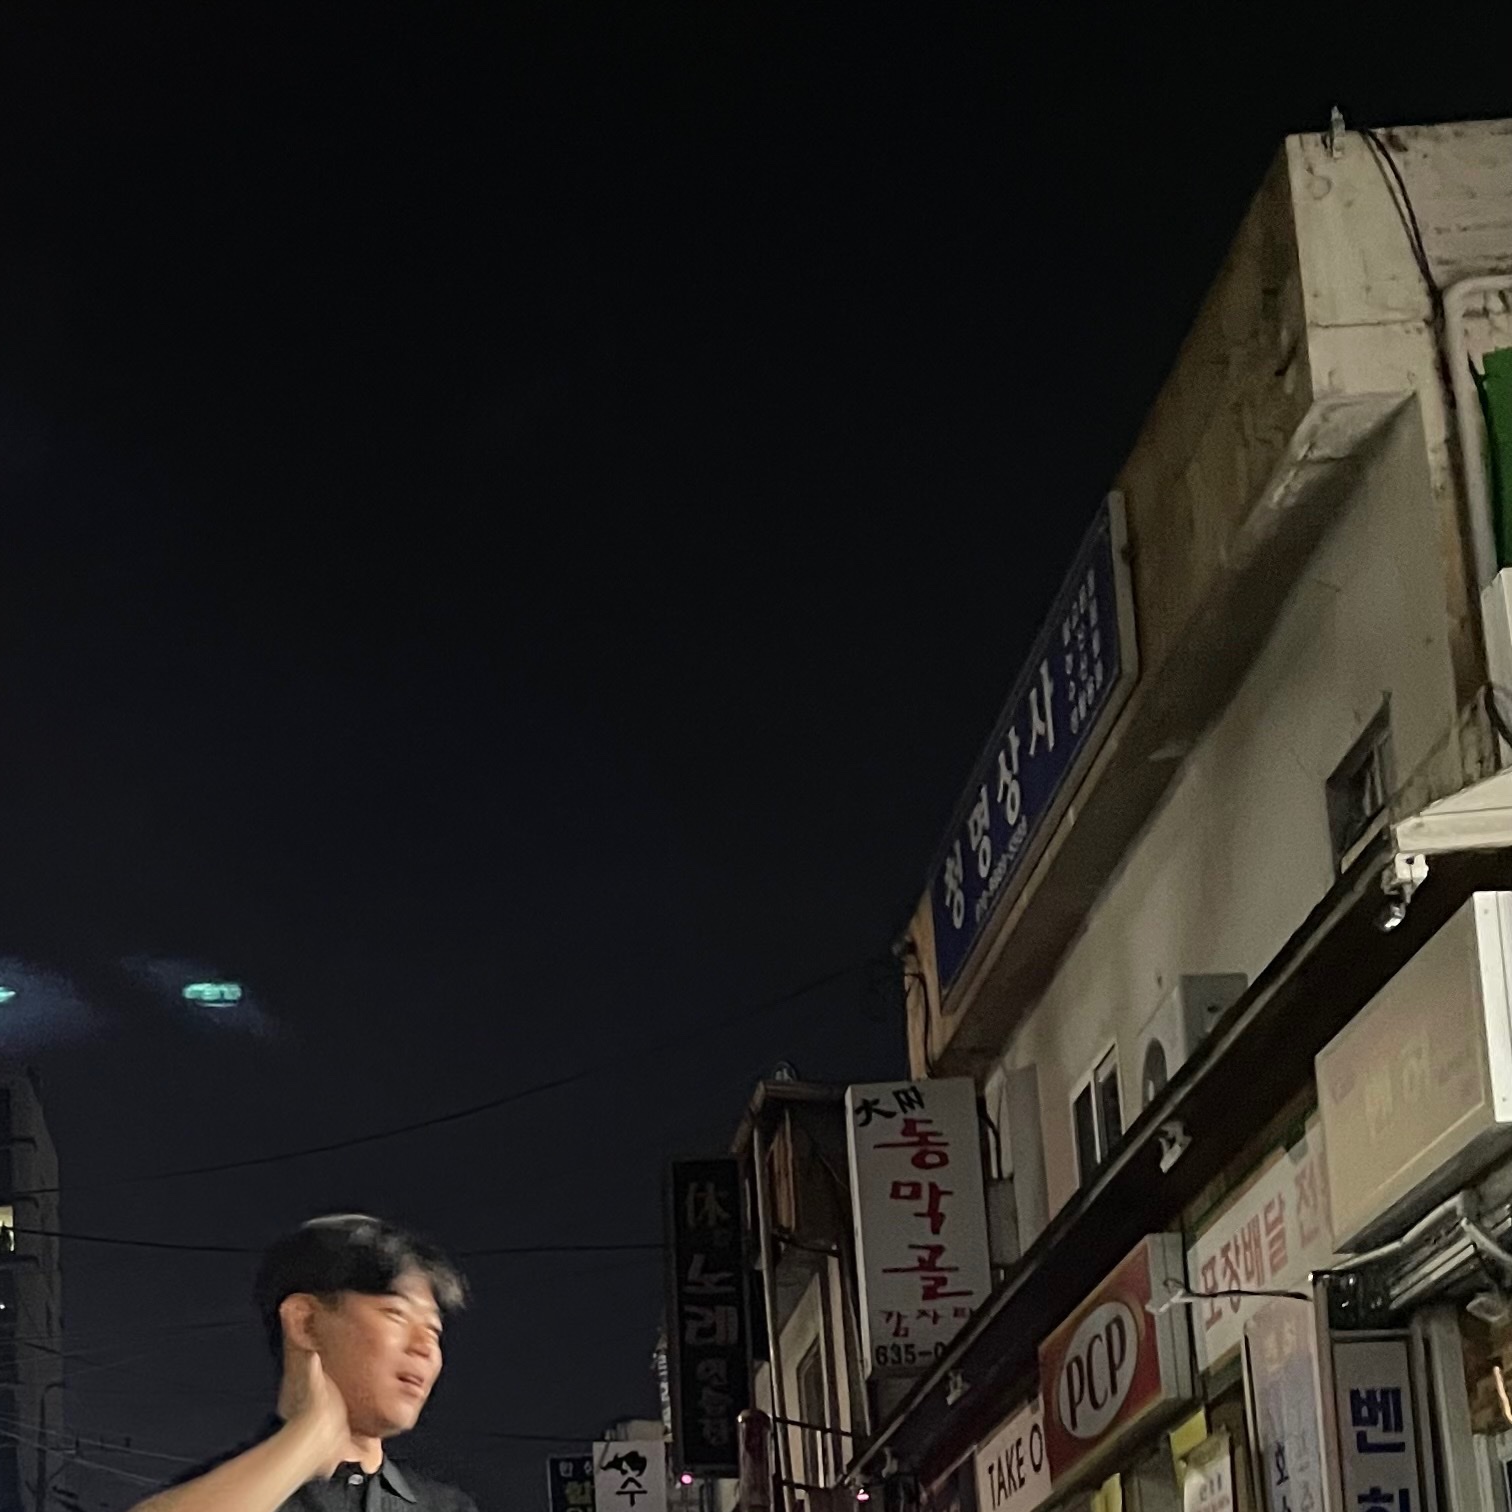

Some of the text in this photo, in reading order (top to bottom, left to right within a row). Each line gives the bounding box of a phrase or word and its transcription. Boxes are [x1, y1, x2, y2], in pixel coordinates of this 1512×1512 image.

[873, 1117, 973, 1301] 동막골
[1065, 1314, 1127, 1430] PCP
[988, 1437, 1026, 1511] TAKE
